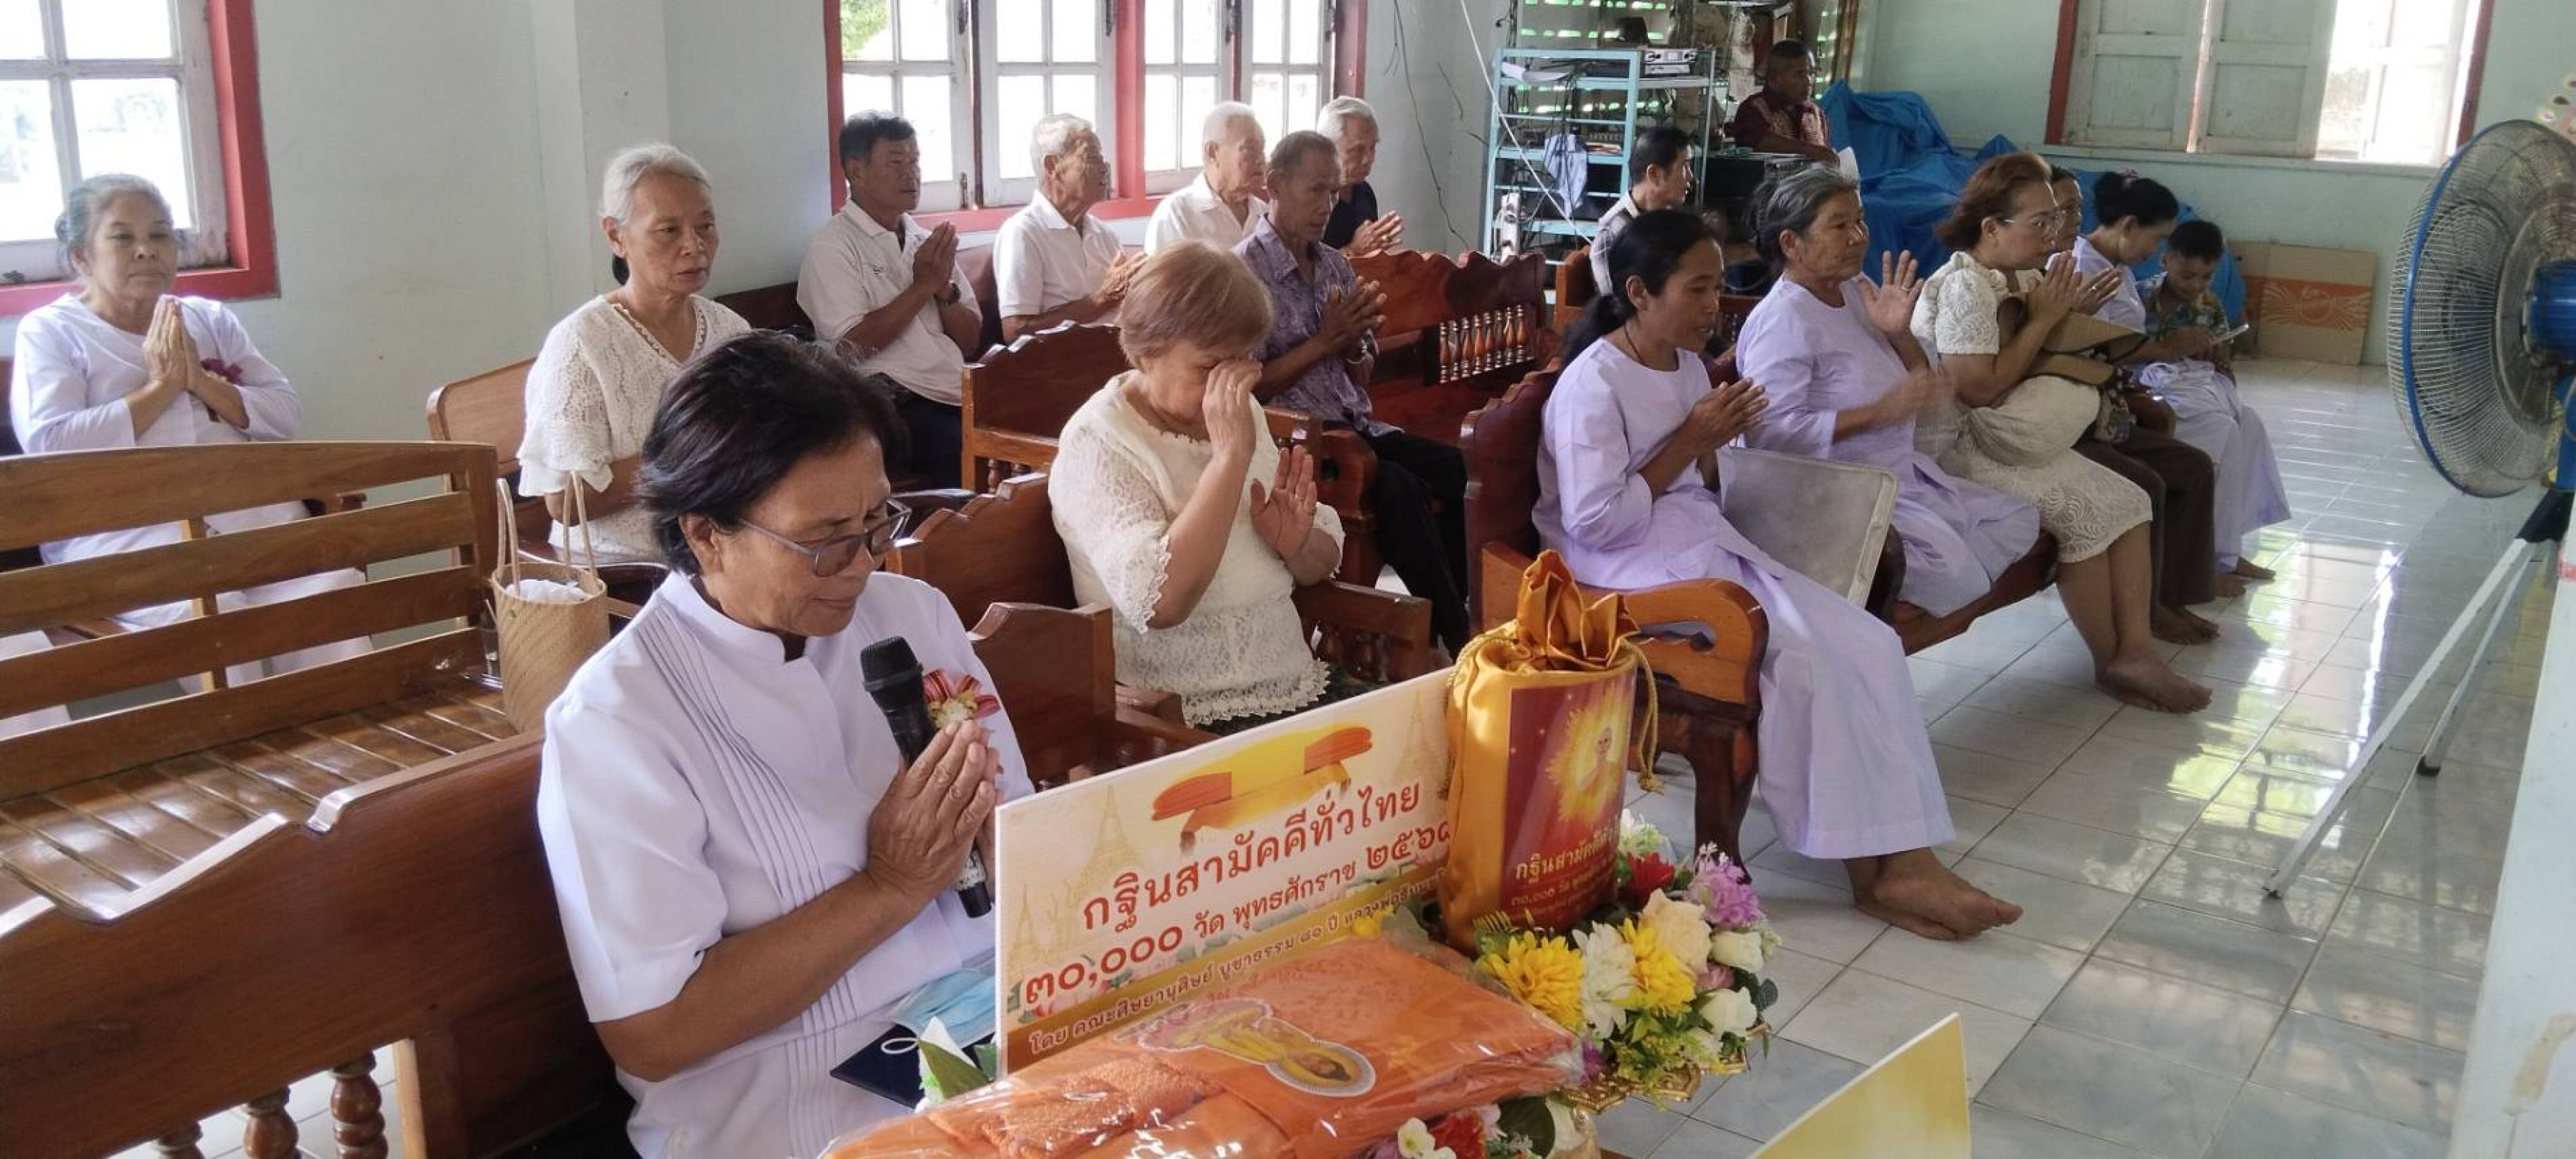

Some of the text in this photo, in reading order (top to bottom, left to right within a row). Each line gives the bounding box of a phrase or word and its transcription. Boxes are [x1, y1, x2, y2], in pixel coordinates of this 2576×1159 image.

[1084, 782, 1419, 933] กฐินสามัคคีทั่วไทย
[1026, 926, 1183, 1004] ๓๐,๐๐๐
[1195, 910, 1225, 939] วัด
[1233, 861, 1356, 930] พุทธศักราช
[1029, 1026, 1069, 1055] โดย
[1074, 963, 1213, 1038] คณะศิษยานุศิษย์
[1220, 937, 1296, 982] บูชาธรรม
[1328, 912, 1339, 932] ปี
